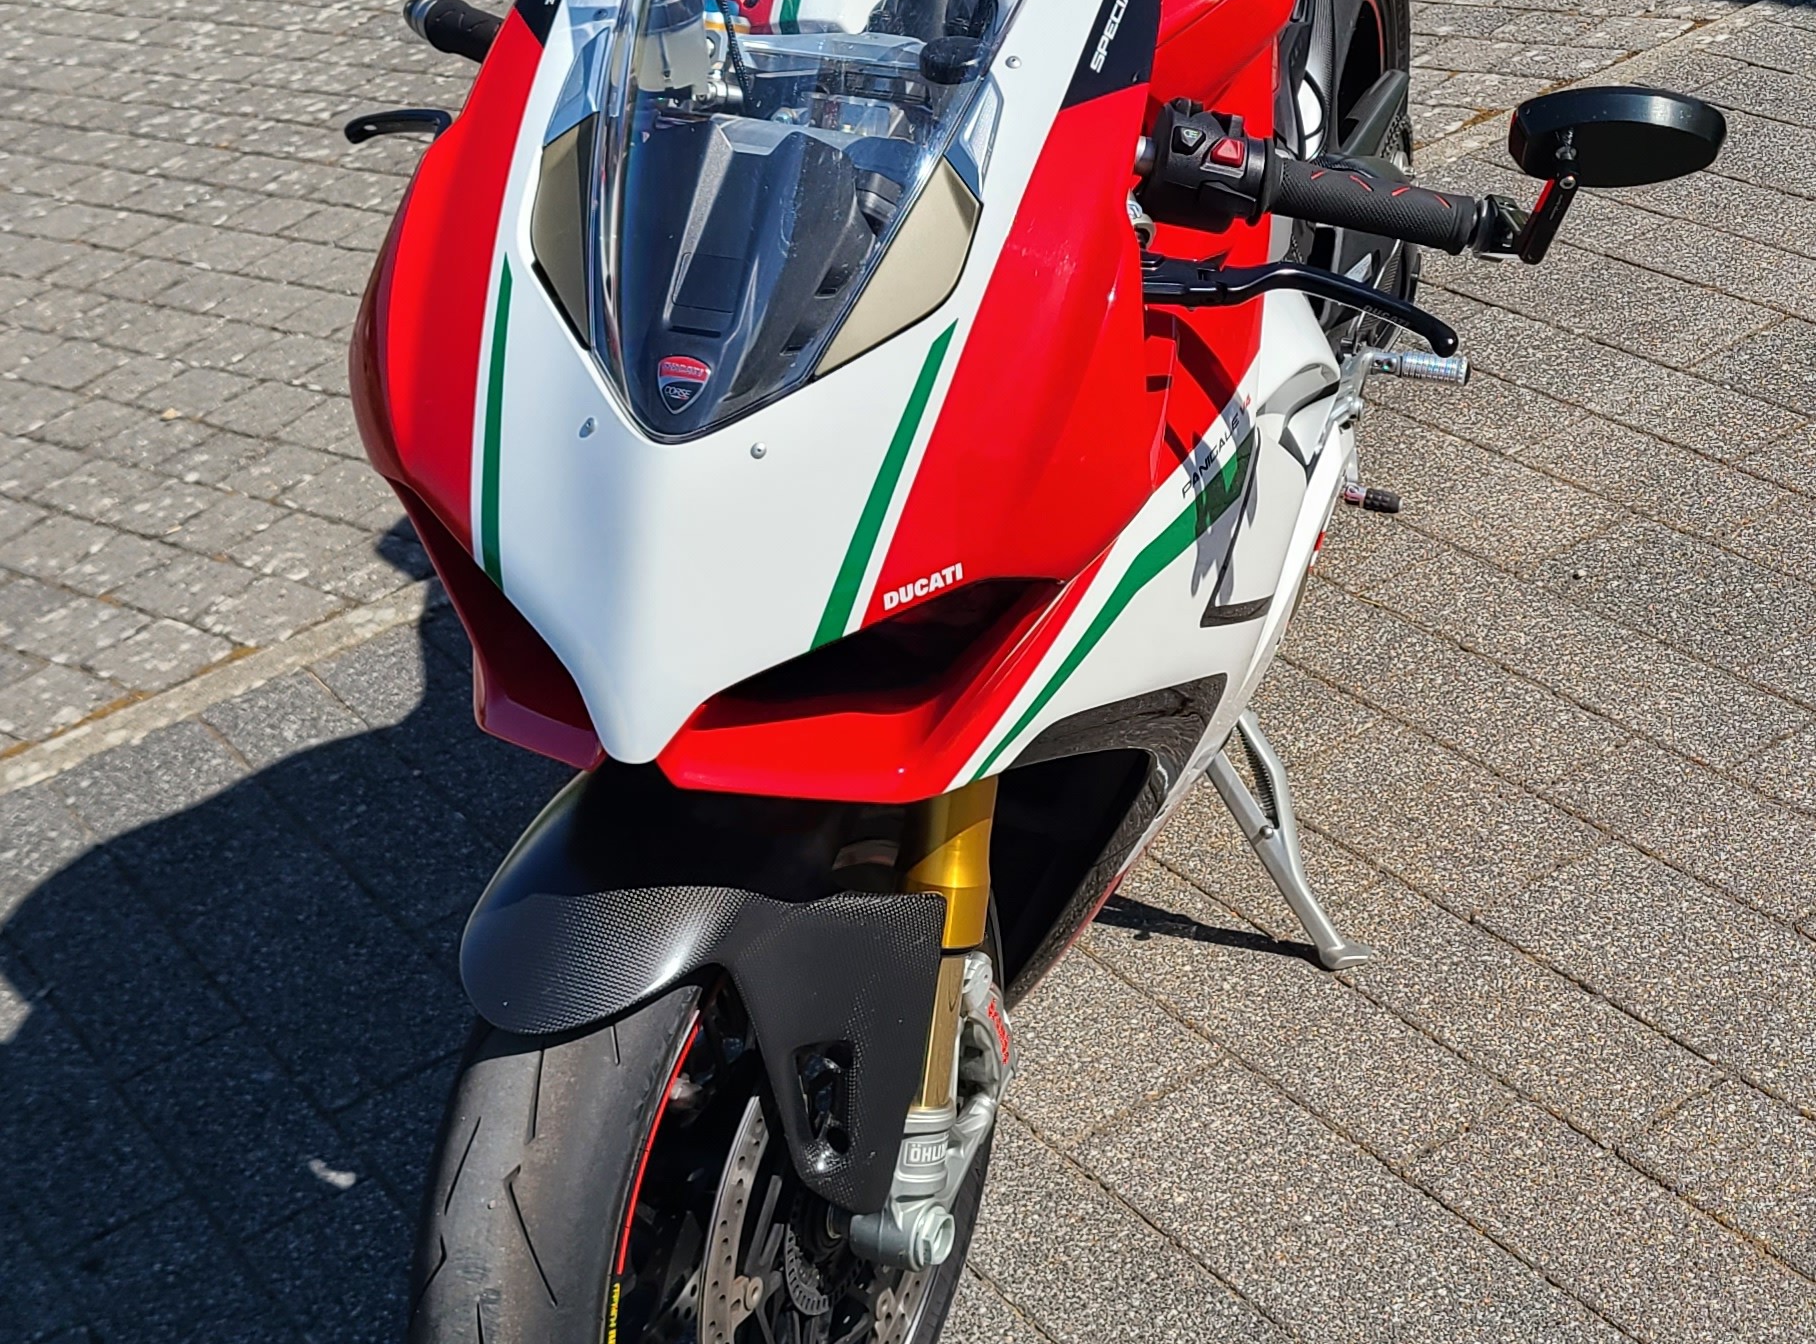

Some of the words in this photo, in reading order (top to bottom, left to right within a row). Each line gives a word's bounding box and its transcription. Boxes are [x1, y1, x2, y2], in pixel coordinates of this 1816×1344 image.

[1182, 413, 1239, 498] PANIGALE
[883, 562, 963, 611] DUCATI
[910, 1143, 947, 1162] ÖHLI
